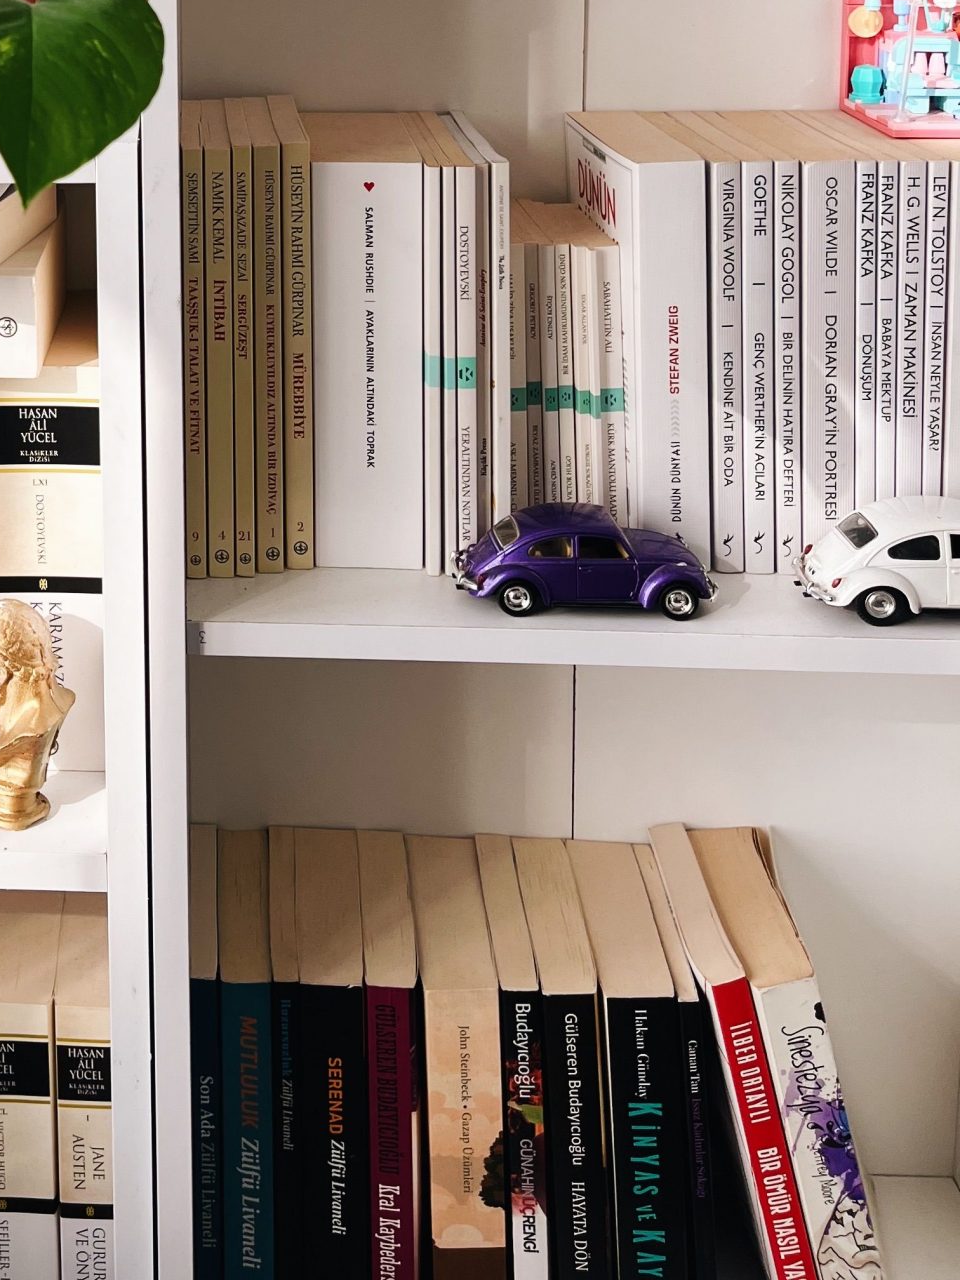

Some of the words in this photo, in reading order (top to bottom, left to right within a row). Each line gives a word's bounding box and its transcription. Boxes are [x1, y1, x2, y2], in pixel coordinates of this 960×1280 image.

[211, 171, 224, 215] NAMIK
[754, 174, 767, 237] GOETHE
[825, 177, 838, 226] OSCAR
[862, 173, 874, 224] FRANZ
[212, 218, 225, 264] KEMAL
[365, 207, 374, 249] SALMAN
[861, 227, 873, 277] KAFKA
[365, 253, 374, 293] RUSHDIE
[825, 229, 838, 277] WILDE
[213, 279, 226, 341] İNTİBAH
[668, 305, 679, 346] ZWEIG
[366, 309, 374, 372] AYAKLARININ
[753, 332, 766, 370] GENÇ
[825, 315, 838, 378] DORIAN
[668, 349, 680, 394] STEFAN
[862, 334, 873, 401] DÖNÜŞÜM
[292, 352, 306, 439] MÜREBBİYE
[366, 377, 375, 426] ALTINDAKİ
[754, 373, 766, 448] WERTHER'İN
[825, 383, 838, 447] GRAY'İN
[366, 430, 376, 469] TOPRAK
[670, 441, 681, 485] DÜNYASI
[754, 453, 766, 501] ACILARI
[824, 450, 838, 521] PORTRESİ
[671, 489, 682, 522] DÜNÜN
[458, 1026, 470, 1052] John
[513, 1003, 533, 1098] Budayıcıoğlu
[564, 1013, 578, 1076] Gülseren
[635, 1009, 649, 1050] Hakan
[729, 1021, 753, 1064] İLBER
[460, 1054, 471, 1103] Steinbeck
[636, 1054, 649, 1099] Günday
[740, 1066, 771, 1124] ORTAYLI
[782, 1026, 824, 1117] Sinestezya
[328, 1058, 343, 1135] SERENAD
[461, 1112, 472, 1144] Gazap
[568, 1079, 585, 1166] Budayıcıoğlu
[73, 1134, 86, 1190] AUSTEN
[90, 1147, 105, 1180] JANE
[328, 1140, 345, 1179] Zülfü
[463, 1148, 474, 1193] Üzümleri
[331, 1181, 346, 1234] Livaneli
[572, 1181, 586, 1236] HAYATA
[574, 1241, 591, 1272] DÖN
